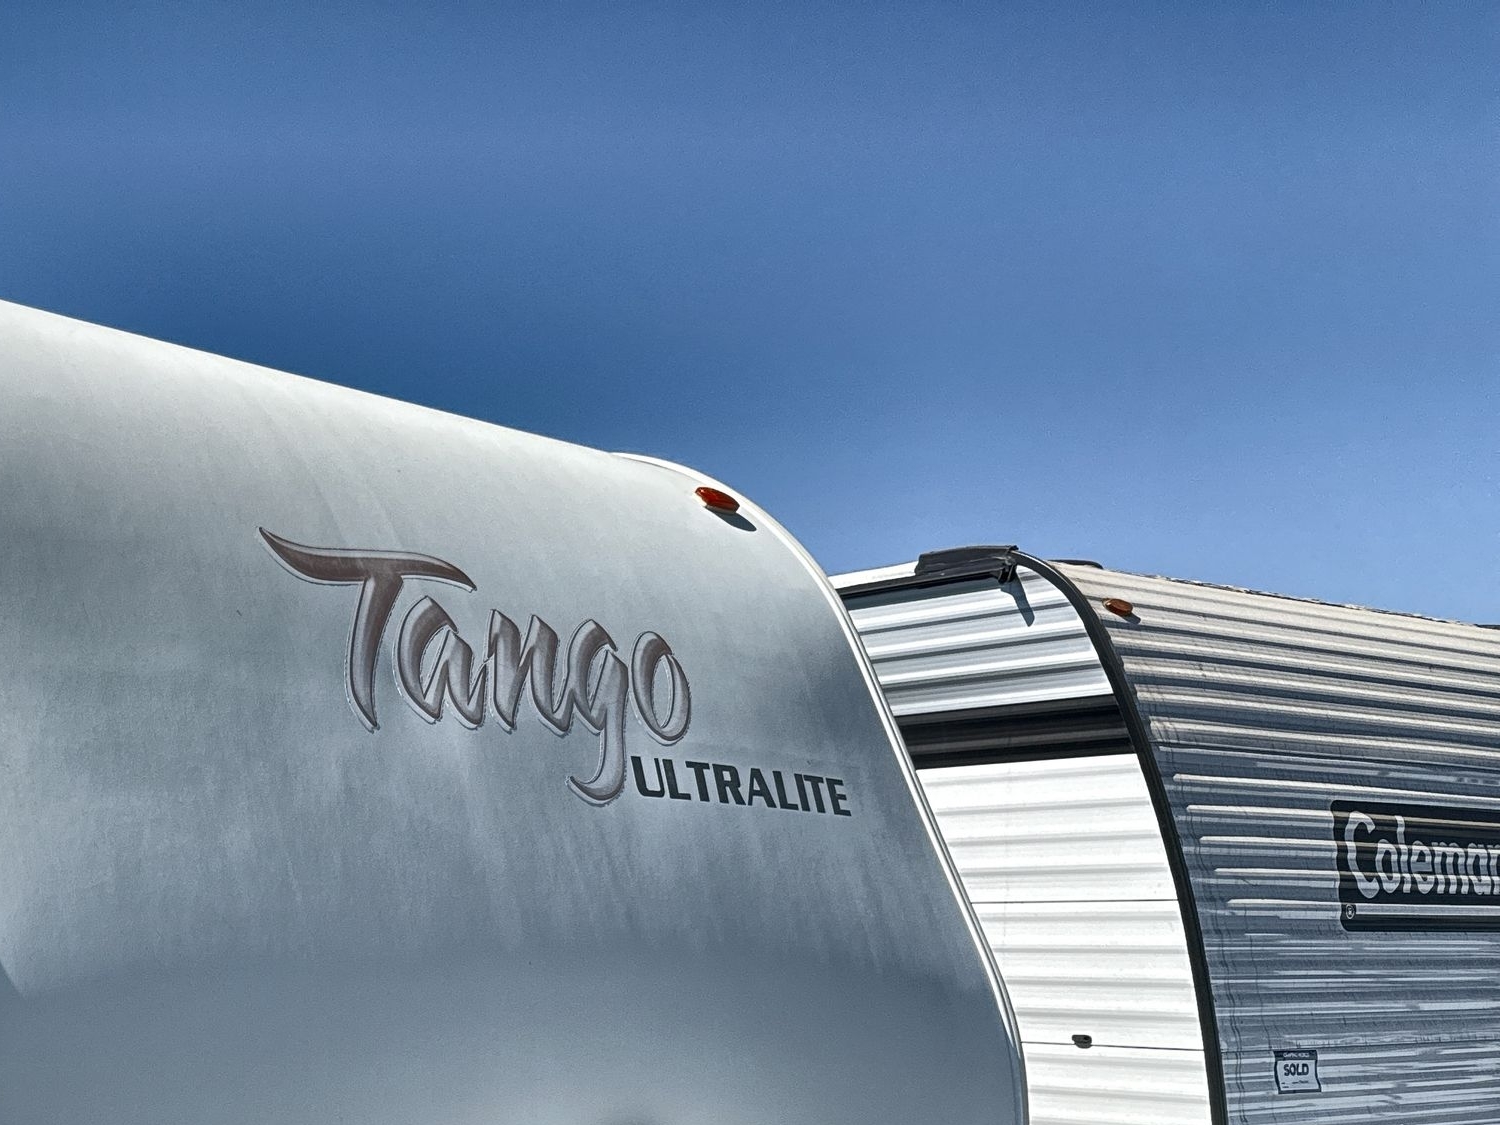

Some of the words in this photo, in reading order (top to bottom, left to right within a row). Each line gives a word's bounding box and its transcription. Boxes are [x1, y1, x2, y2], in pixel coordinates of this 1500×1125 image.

[256, 525, 692, 806] Tango
[631, 756, 852, 817] ULTRALITE
[1283, 1063, 1309, 1076] SOLD
